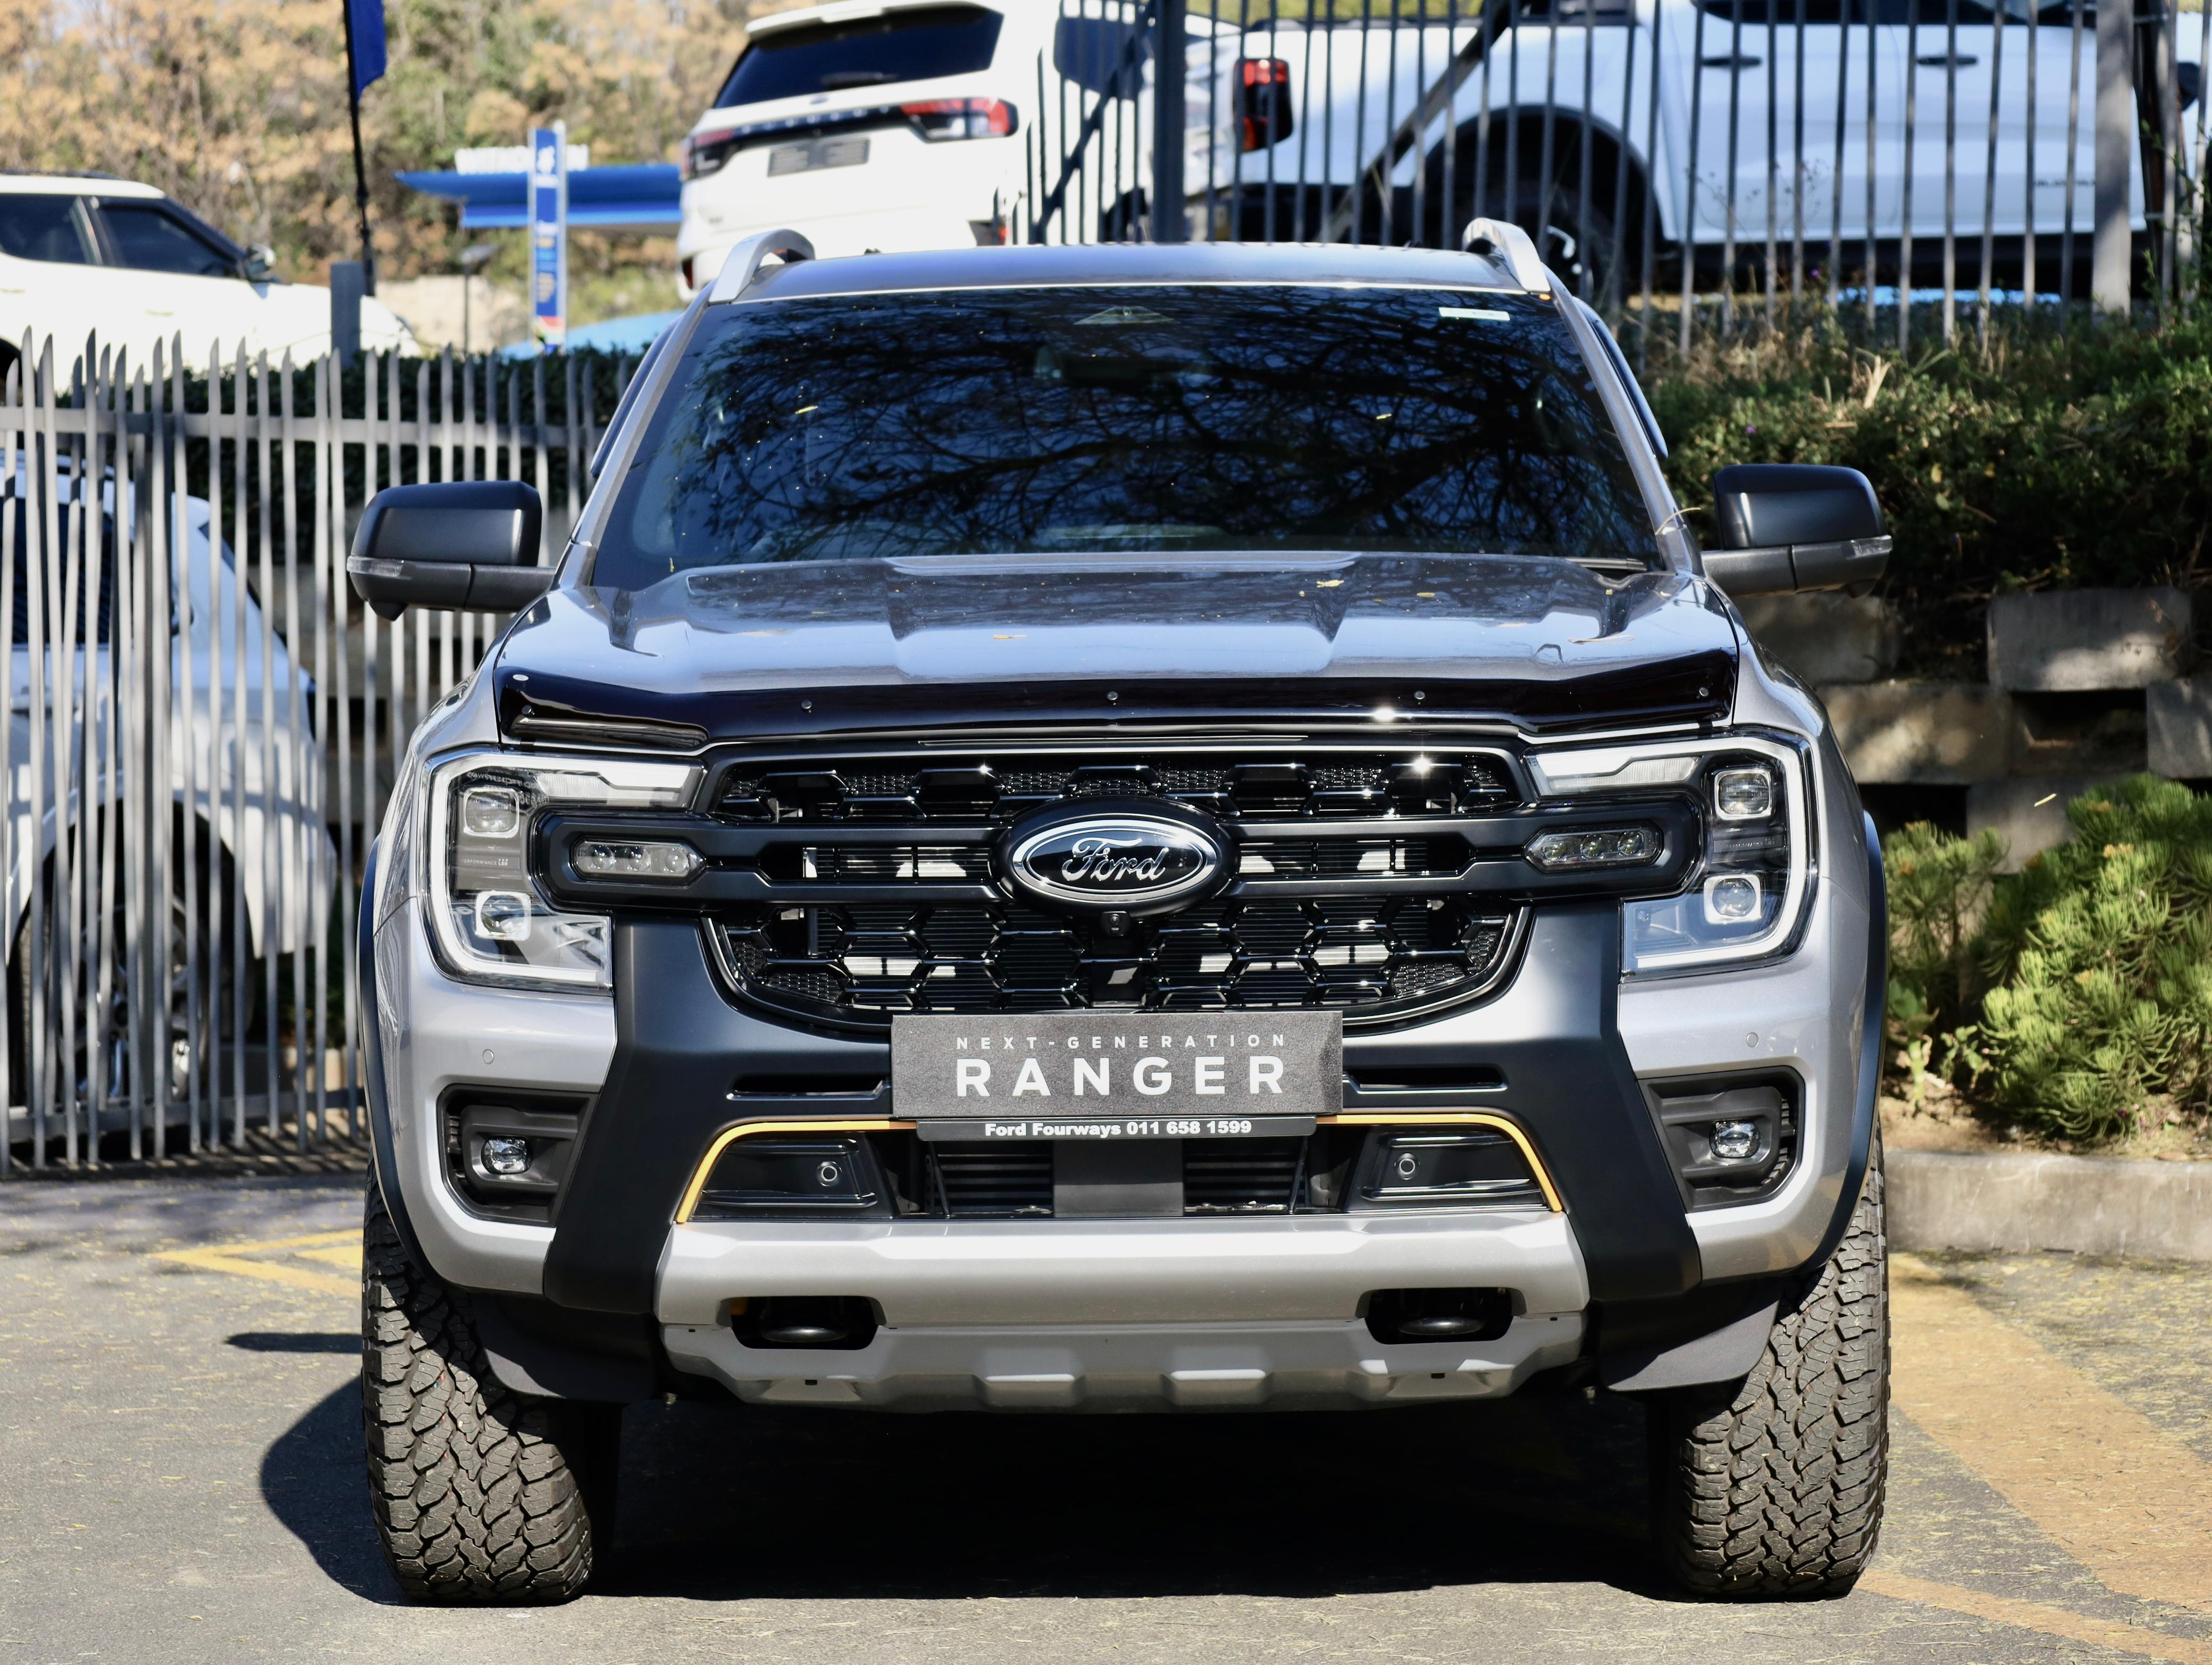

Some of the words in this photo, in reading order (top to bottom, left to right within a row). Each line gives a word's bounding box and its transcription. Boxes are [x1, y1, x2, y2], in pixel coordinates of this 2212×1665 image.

[1062, 837, 1169, 881] Ford
[957, 1034, 1284, 1049] NEXT-GENERATION
[957, 1055, 1284, 1097] RANGER
[985, 1123, 1027, 1136] Ford
[1032, 1122, 1121, 1138] Fourways
[1126, 1121, 1159, 1134] 011
[1166, 1121, 1201, 1134] 658
[1206, 1120, 1252, 1133] 1599
